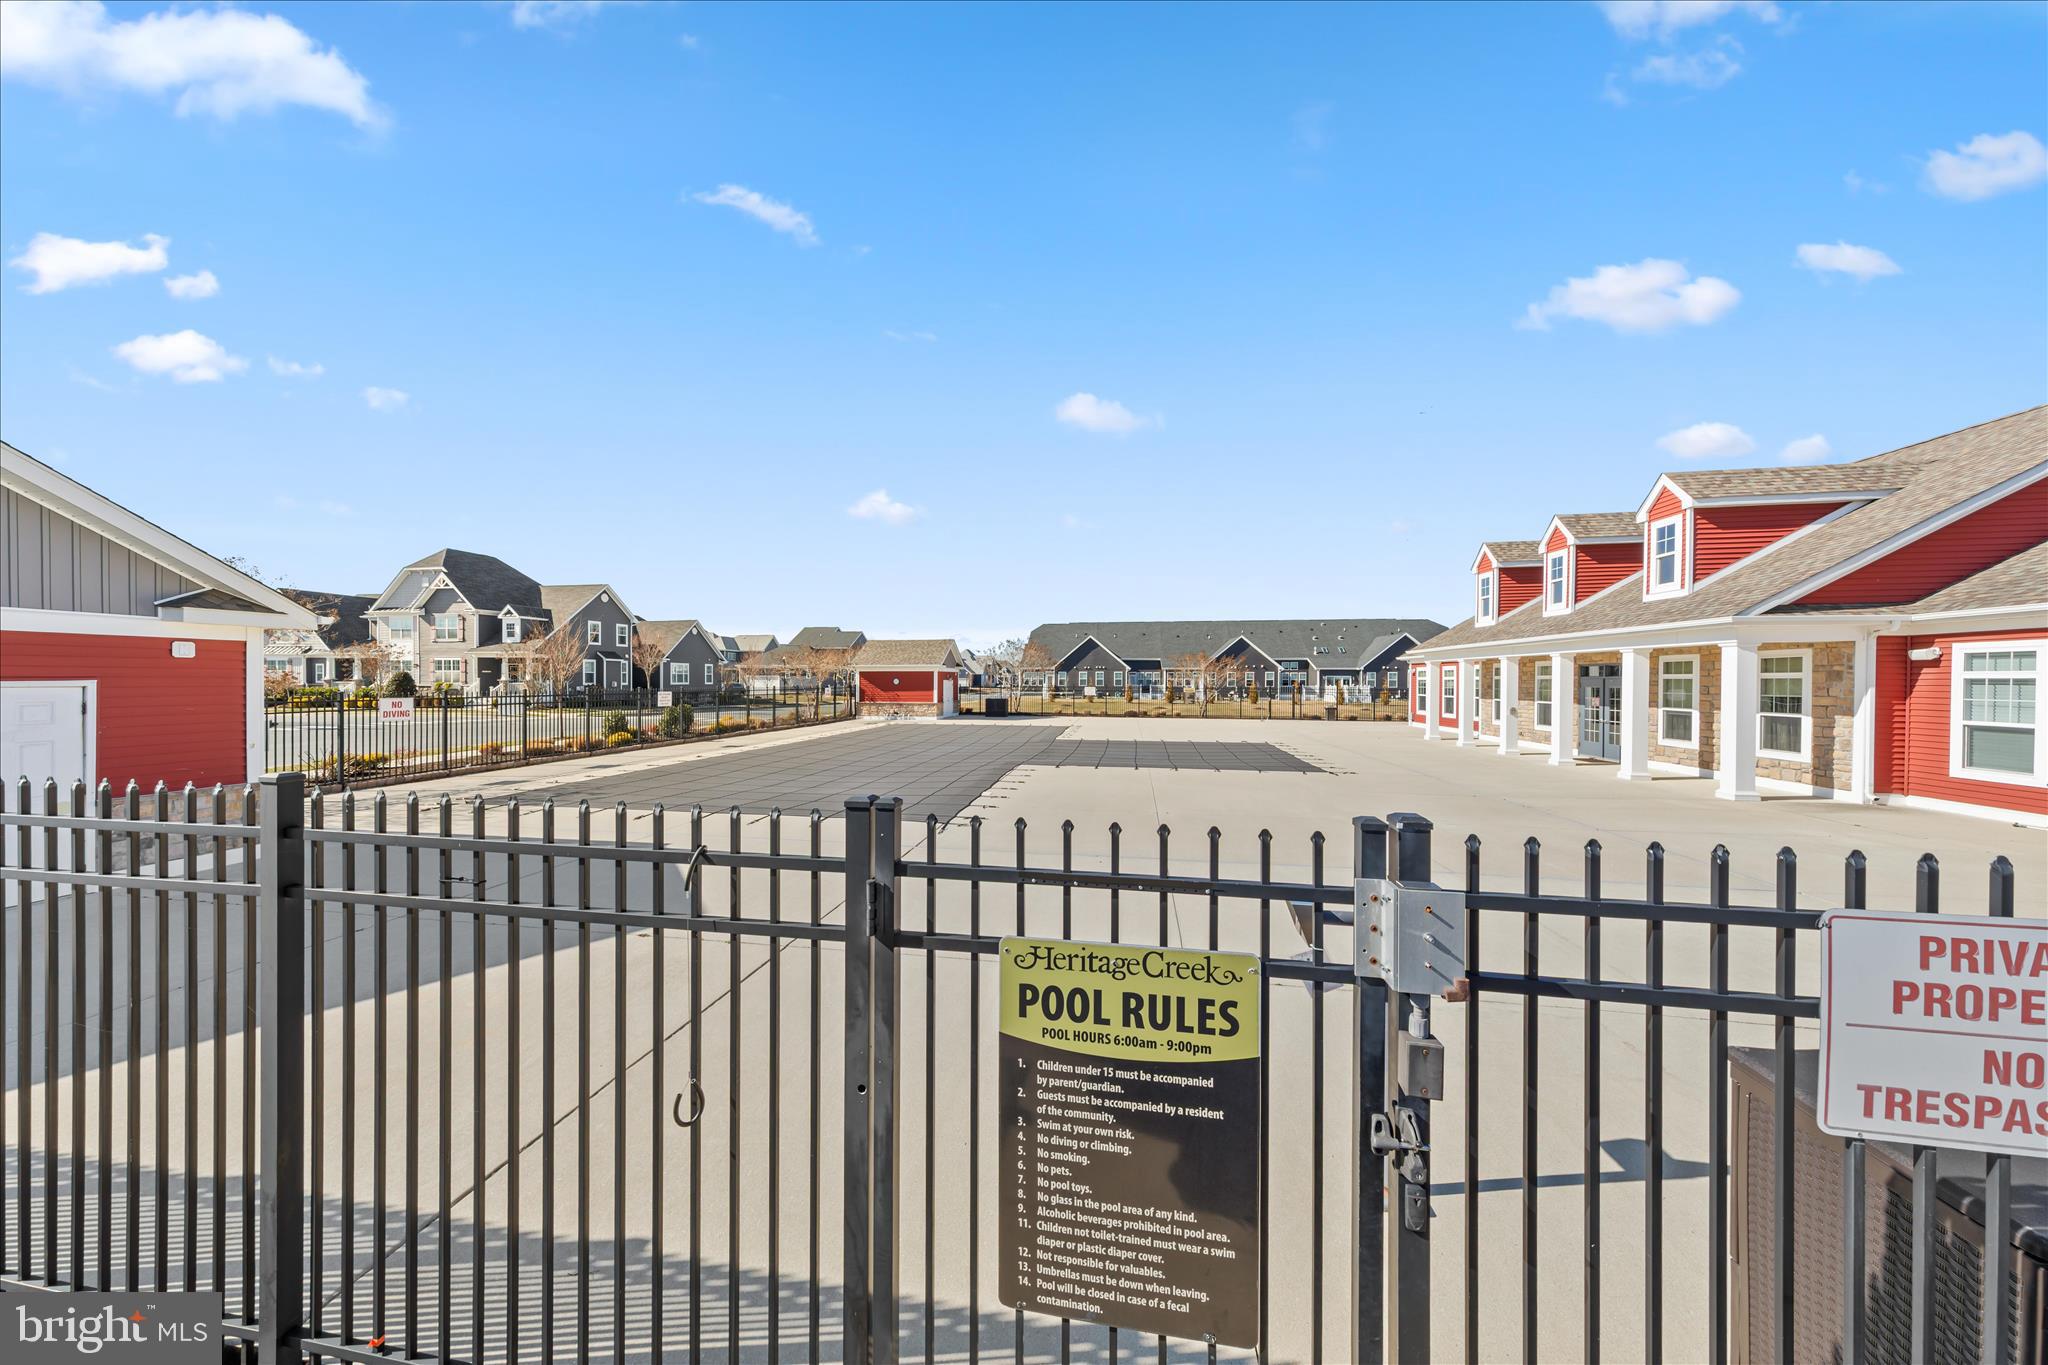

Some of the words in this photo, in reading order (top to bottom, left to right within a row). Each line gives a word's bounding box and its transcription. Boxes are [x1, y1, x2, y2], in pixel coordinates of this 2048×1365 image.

[383, 710, 410, 718] DIVING
[1018, 983, 1111, 1026] POOL
[1122, 992, 1240, 1037] RULES
[1892, 980, 2046, 1025] PROPE
[1042, 1027, 1071, 1042] POOL
[1073, 1030, 1111, 1045] HOURS
[1113, 1034, 1157, 1050] 6:00am
[1166, 1039, 1212, 1056] 9:00pm
[1017, 1058, 1026, 1068] 1.
[1037, 1059, 1073, 1073] Children
[1075, 1064, 1102, 1076] under
[1103, 1067, 1114, 1077] 15
[1115, 1070, 1139, 1080] must
[1140, 1070, 1152, 1082] be
[1152, 1074, 1214, 1088] accompanied
[1036, 1074, 1048, 1087] by
[1048, 1078, 1125, 1094] parent/guardian.
[1983, 1049, 2045, 1089] NO
[1017, 1087, 1026, 1097] 2.
[1037, 1089, 1066, 1102] Guests
[1067, 1094, 1090, 1105] must
[1091, 1095, 1103, 1106] be
[1103, 1099, 1163, 1113] accompanied
[1164, 1103, 1176, 1117] by
[1177, 1106, 1184, 1115] a
[1185, 1107, 1224, 1120] resident
[1036, 1104, 1047, 1114] of
[1047, 1105, 1063, 1116] the
[1064, 1109, 1116, 1125] community.
[1017, 1116, 1026, 1127] 3.
[1037, 1118, 1061, 1131] Swim
[1062, 1123, 1072, 1132] at
[1073, 1125, 1094, 1135] your
[1094, 1128, 1114, 1137] own
[1115, 1128, 1135, 1140] risk.
[1017, 1131, 1026, 1141] 4.
[1037, 1133, 1049, 1144] No
[1050, 1135, 1078, 1150] diving
[1079, 1140, 1089, 1149] or
[1090, 1140, 1132, 1156] climbing.
[1017, 1145, 1026, 1156] 5.
[1037, 1147, 1049, 1159] No
[1050, 1151, 1090, 1166] smoking.
[1017, 1160, 1026, 1170] 6.
[1037, 1162, 1049, 1173] No
[1050, 1166, 1072, 1176] pets.
[1017, 1174, 1026, 1184] 7.
[1037, 1176, 1049, 1188] No
[1050, 1180, 1070, 1191] pool
[1071, 1182, 1092, 1195] toys.
[1017, 1188, 1026, 1199] 8.
[1037, 1191, 1049, 1202] No
[1050, 1193, 1073, 1206] glass
[1074, 1196, 1083, 1207] in
[1084, 1198, 1100, 1210] the
[1101, 1202, 1121, 1213] pool
[1122, 1205, 1143, 1216] area
[1144, 1207, 1155, 1217] of
[1155, 1210, 1173, 1222] any
[1174, 1210, 1197, 1223] kind.
[1017, 1203, 1026, 1213] 9.
[1037, 1206, 1076, 1221] Alcoholic
[1077, 1211, 1122, 1229] beverages
[1123, 1220, 1171, 1235] prohibited
[1173, 1225, 1182, 1236] in
[1184, 1229, 1205, 1239] pool
[1206, 1232, 1231, 1243] area.
[1018, 1217, 1031, 1229] 11.
[1036, 1220, 1073, 1235] Children
[1074, 1228, 1090, 1238] not
[1091, 1229, 1152, 1247] toilet-trained
[1153, 1240, 1176, 1251] must
[1178, 1243, 1202, 1254] wear
[1203, 1247, 1209, 1255] a
[1210, 1247, 1236, 1259] swim
[1018, 1246, 1031, 1258] 12.
[1036, 1249, 1052, 1261] Not
[1053, 1254, 1104, 1270] responsible
[1105, 1260, 1119, 1272] for
[1120, 1264, 1166, 1279] valuables.
[1036, 1234, 1065, 1249] diaper
[1066, 1241, 1076, 1250] or
[1077, 1241, 1106, 1255] plastic
[1107, 1246, 1137, 1260] diaper
[1138, 1252, 1165, 1264] cover.
[1018, 1261, 1031, 1272] 13.
[1036, 1263, 1080, 1280] Umbrellas
[1081, 1273, 1104, 1284] must
[1105, 1275, 1117, 1287] be
[1118, 1277, 1144, 1291] down
[1145, 1282, 1171, 1295] when
[1172, 1285, 1210, 1303] leaving.
[1018, 1275, 1031, 1287] 14.
[1036, 1278, 1056, 1291] Pool
[1056, 1283, 1073, 1294] will
[1075, 1284, 1086, 1296] be
[1087, 1287, 1115, 1301] closed
[1116, 1291, 1126, 1303] in
[1127, 1296, 1147, 1306] case
[1148, 1297, 1159, 1308] of
[1159, 1301, 1166, 1309] a
[1167, 1299, 1189, 1313] fecal
[1036, 1295, 1103, 1314] contamination.
